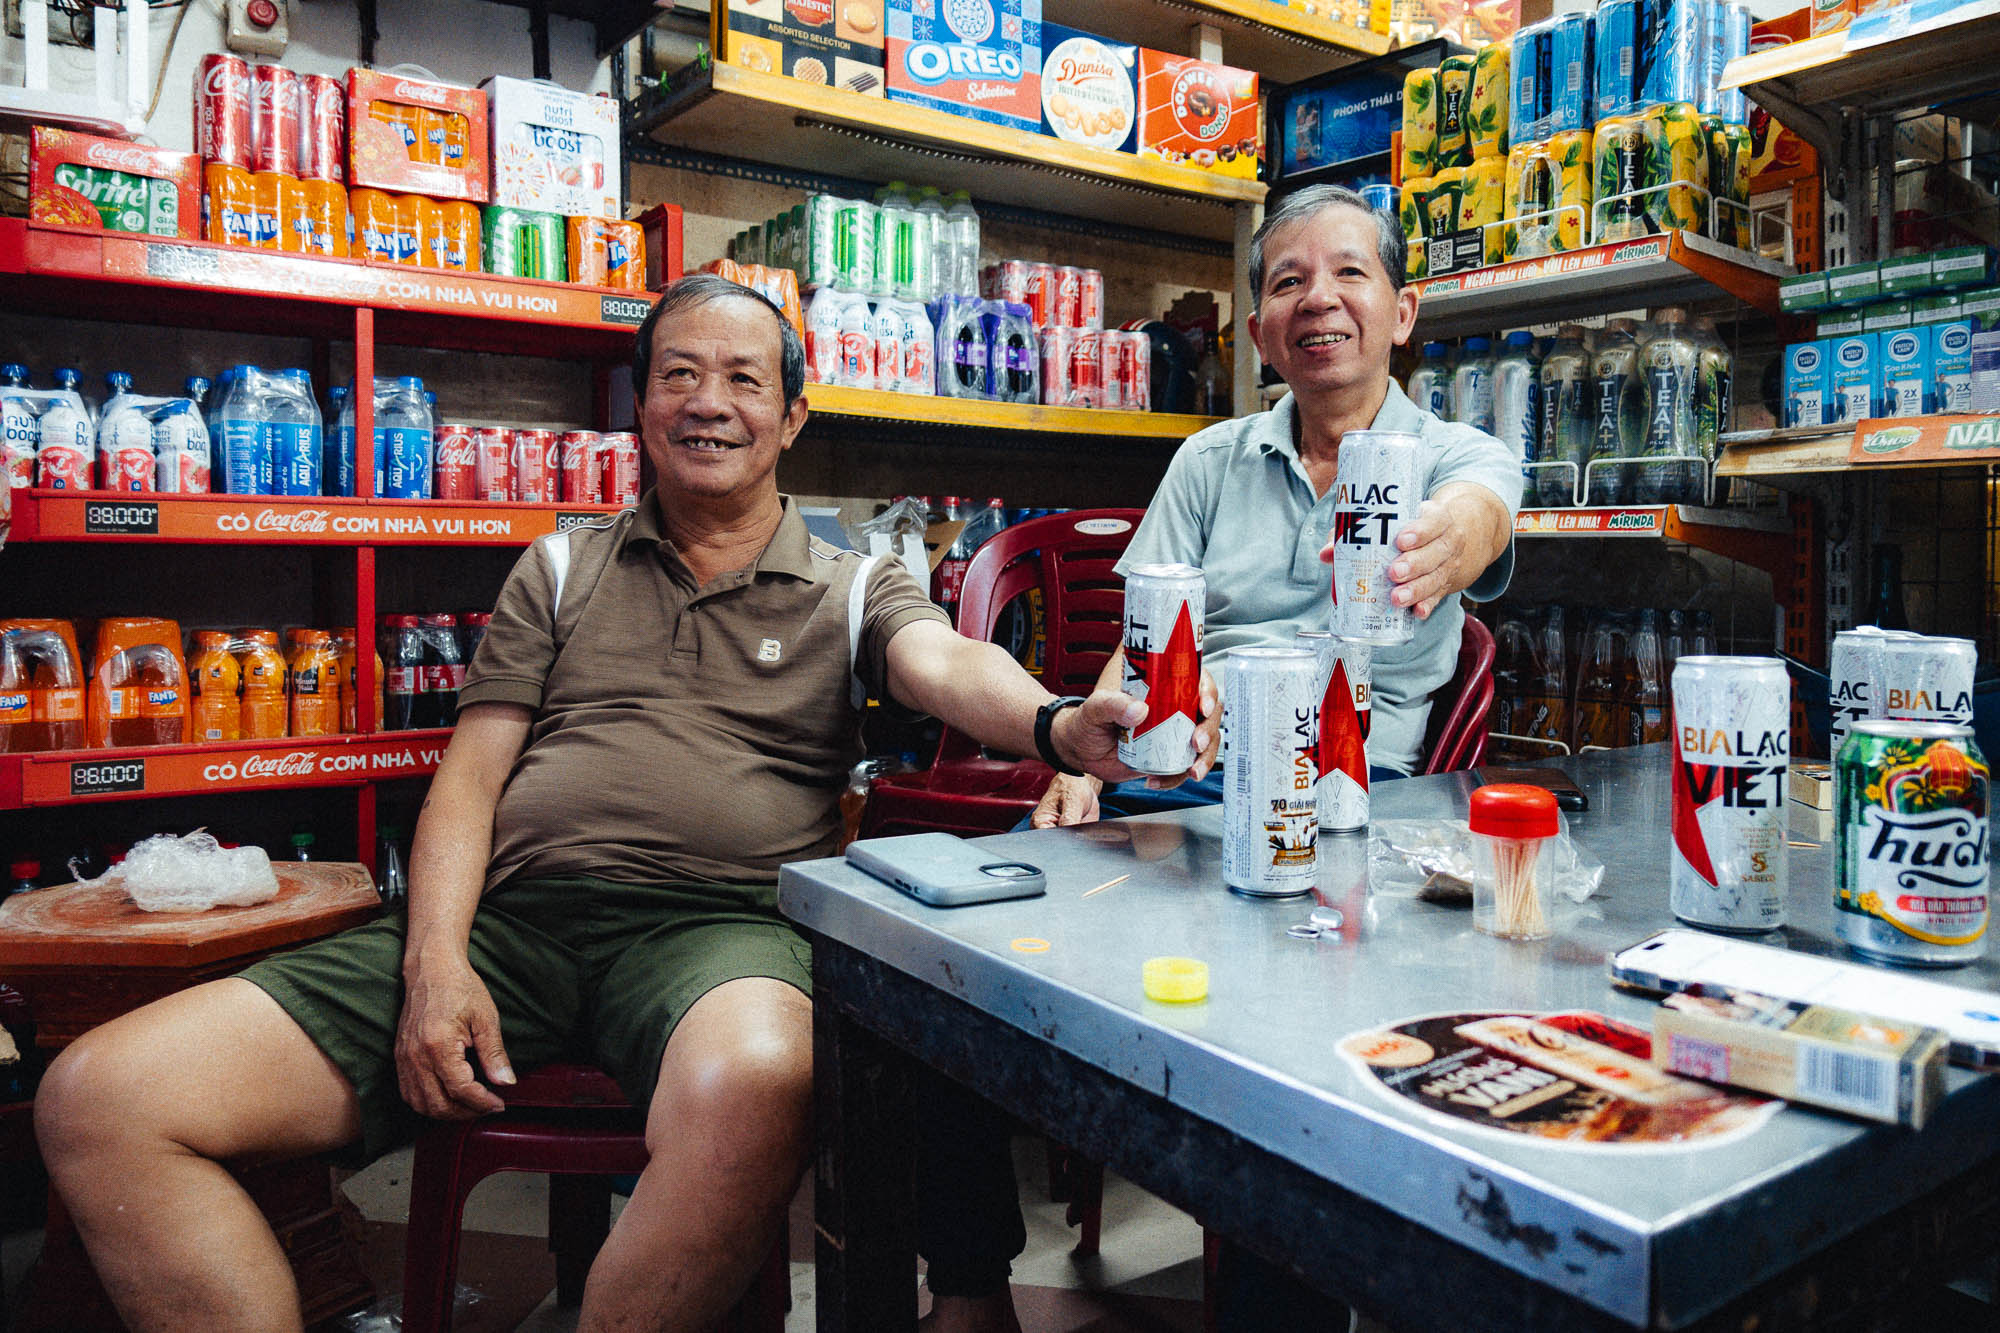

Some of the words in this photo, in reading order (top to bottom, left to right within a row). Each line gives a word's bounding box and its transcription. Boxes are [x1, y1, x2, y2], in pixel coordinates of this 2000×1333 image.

[768, 23, 809, 40] ASSORTED
[810, 33, 851, 50] SELECTION
[908, 44, 1021, 79] OREO
[1056, 58, 1114, 81] Danisa
[967, 82, 1016, 102] Selection
[544, 104, 573, 117] nutri
[1333, 100, 1368, 118] PHONG
[1370, 91, 1393, 108] THÁI
[544, 112, 573, 126] boost
[1200, 102, 1228, 137] DONUT
[533, 129, 582, 153] boost
[56, 169, 147, 206] Sprite
[159, 197, 175, 214] 6
[1464, 270, 1495, 289] NGON
[436, 287, 477, 305] NHÀ
[481, 291, 513, 309] VUI
[517, 295, 558, 313] HƠN
[1853, 394, 1866, 403] 2X
[1904, 389, 1918, 398] 2X
[1956, 383, 1971, 392] 2X
[1807, 399, 1818, 408] 2X
[1945, 417, 2000, 448] NĂ
[294, 428, 315, 487] AQUARIUS
[217, 509, 250, 532] CÓ
[254, 508, 331, 534] Coca-Cola
[332, 516, 379, 534] CƠM
[385, 514, 428, 534] NHÀ
[433, 518, 464, 535] VUI
[470, 518, 511, 535] HƠN
[148, 690, 179, 702] FANTA
[203, 760, 236, 781] CÓ
[241, 751, 318, 779] Coca-Cola
[320, 754, 367, 772] CƠM
[372, 748, 416, 769] NHÀ
[1271, 799, 1288, 812] 70
